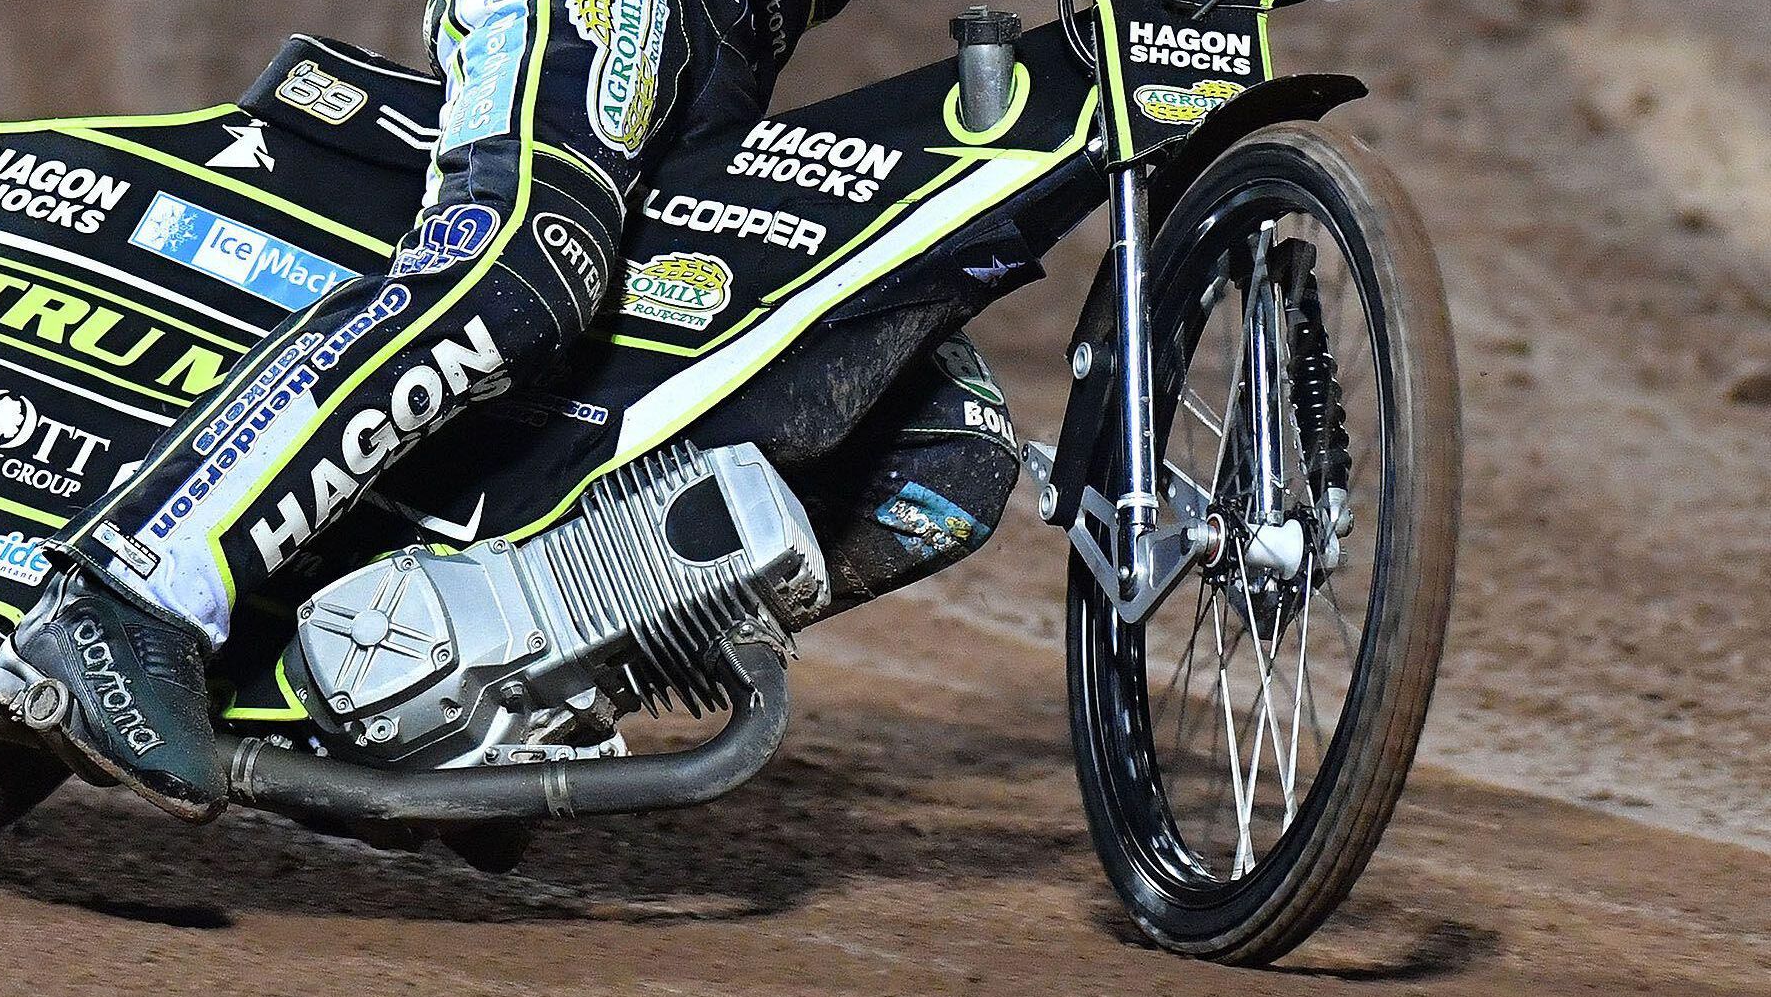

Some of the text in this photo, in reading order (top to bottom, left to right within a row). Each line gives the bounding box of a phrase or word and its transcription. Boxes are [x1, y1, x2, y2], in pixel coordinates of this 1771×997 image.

[1129, 20, 1251, 57] HAGON
[1129, 44, 1251, 76] SHOCKS
[740, 120, 903, 181] HAGON
[726, 151, 880, 203] SHOCKS
[210, 226, 253, 261] Ice
[625, 274, 712, 307] OMIX
[314, 285, 410, 370] Grant
[194, 333, 323, 453] Tankers
[149, 366, 316, 540] Henderson
[249, 315, 505, 573] HAGON
[1, 457, 82, 498] GROUP
